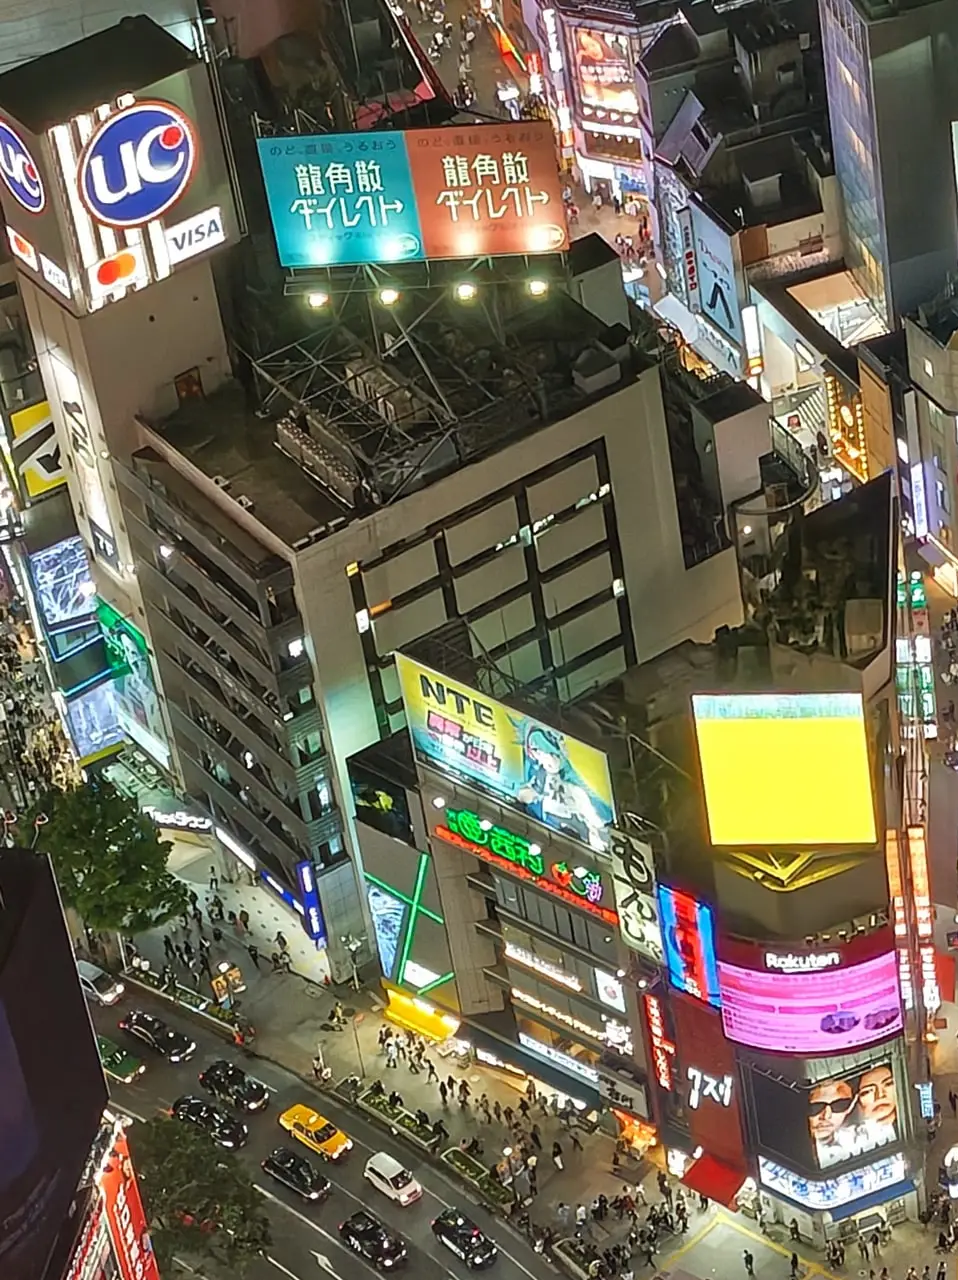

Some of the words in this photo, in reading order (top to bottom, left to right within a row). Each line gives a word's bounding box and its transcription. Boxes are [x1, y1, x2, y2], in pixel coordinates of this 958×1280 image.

[294, 159, 385, 197] 龍角散
[441, 151, 531, 188] 龍角散
[169, 218, 221, 252] VISA
[419, 673, 495, 727] NTE
[765, 952, 840, 970] Rakuten
